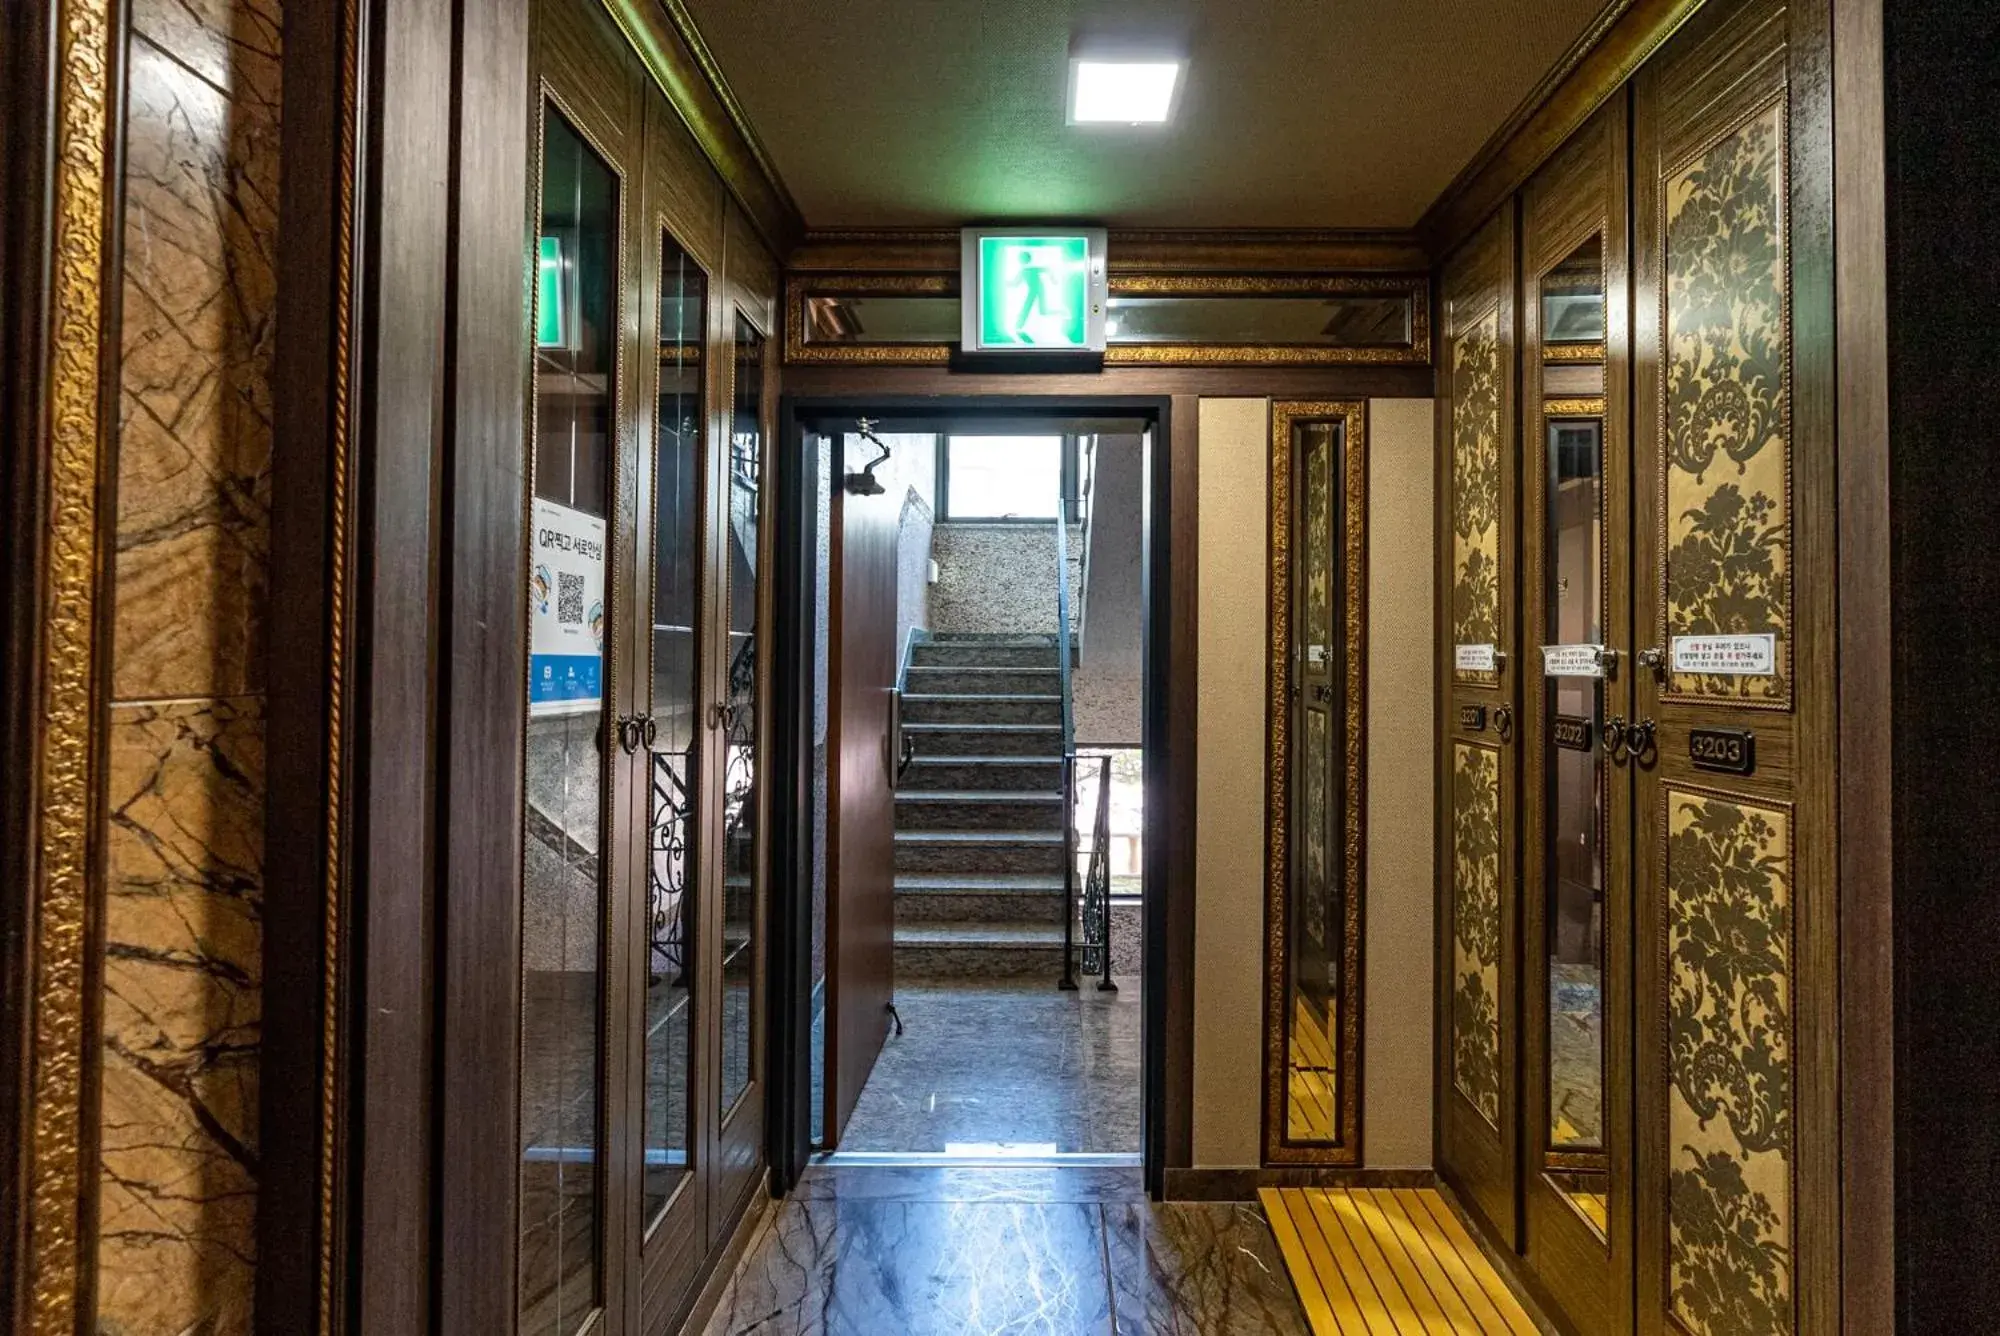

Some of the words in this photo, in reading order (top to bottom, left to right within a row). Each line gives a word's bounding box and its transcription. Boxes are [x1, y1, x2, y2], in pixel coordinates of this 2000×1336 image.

[540, 528, 571, 551] QR찍고
[573, 537, 602, 561] 서로안심
[1554, 723, 1582, 743] 3202
[1692, 736, 1740, 761] 3203
